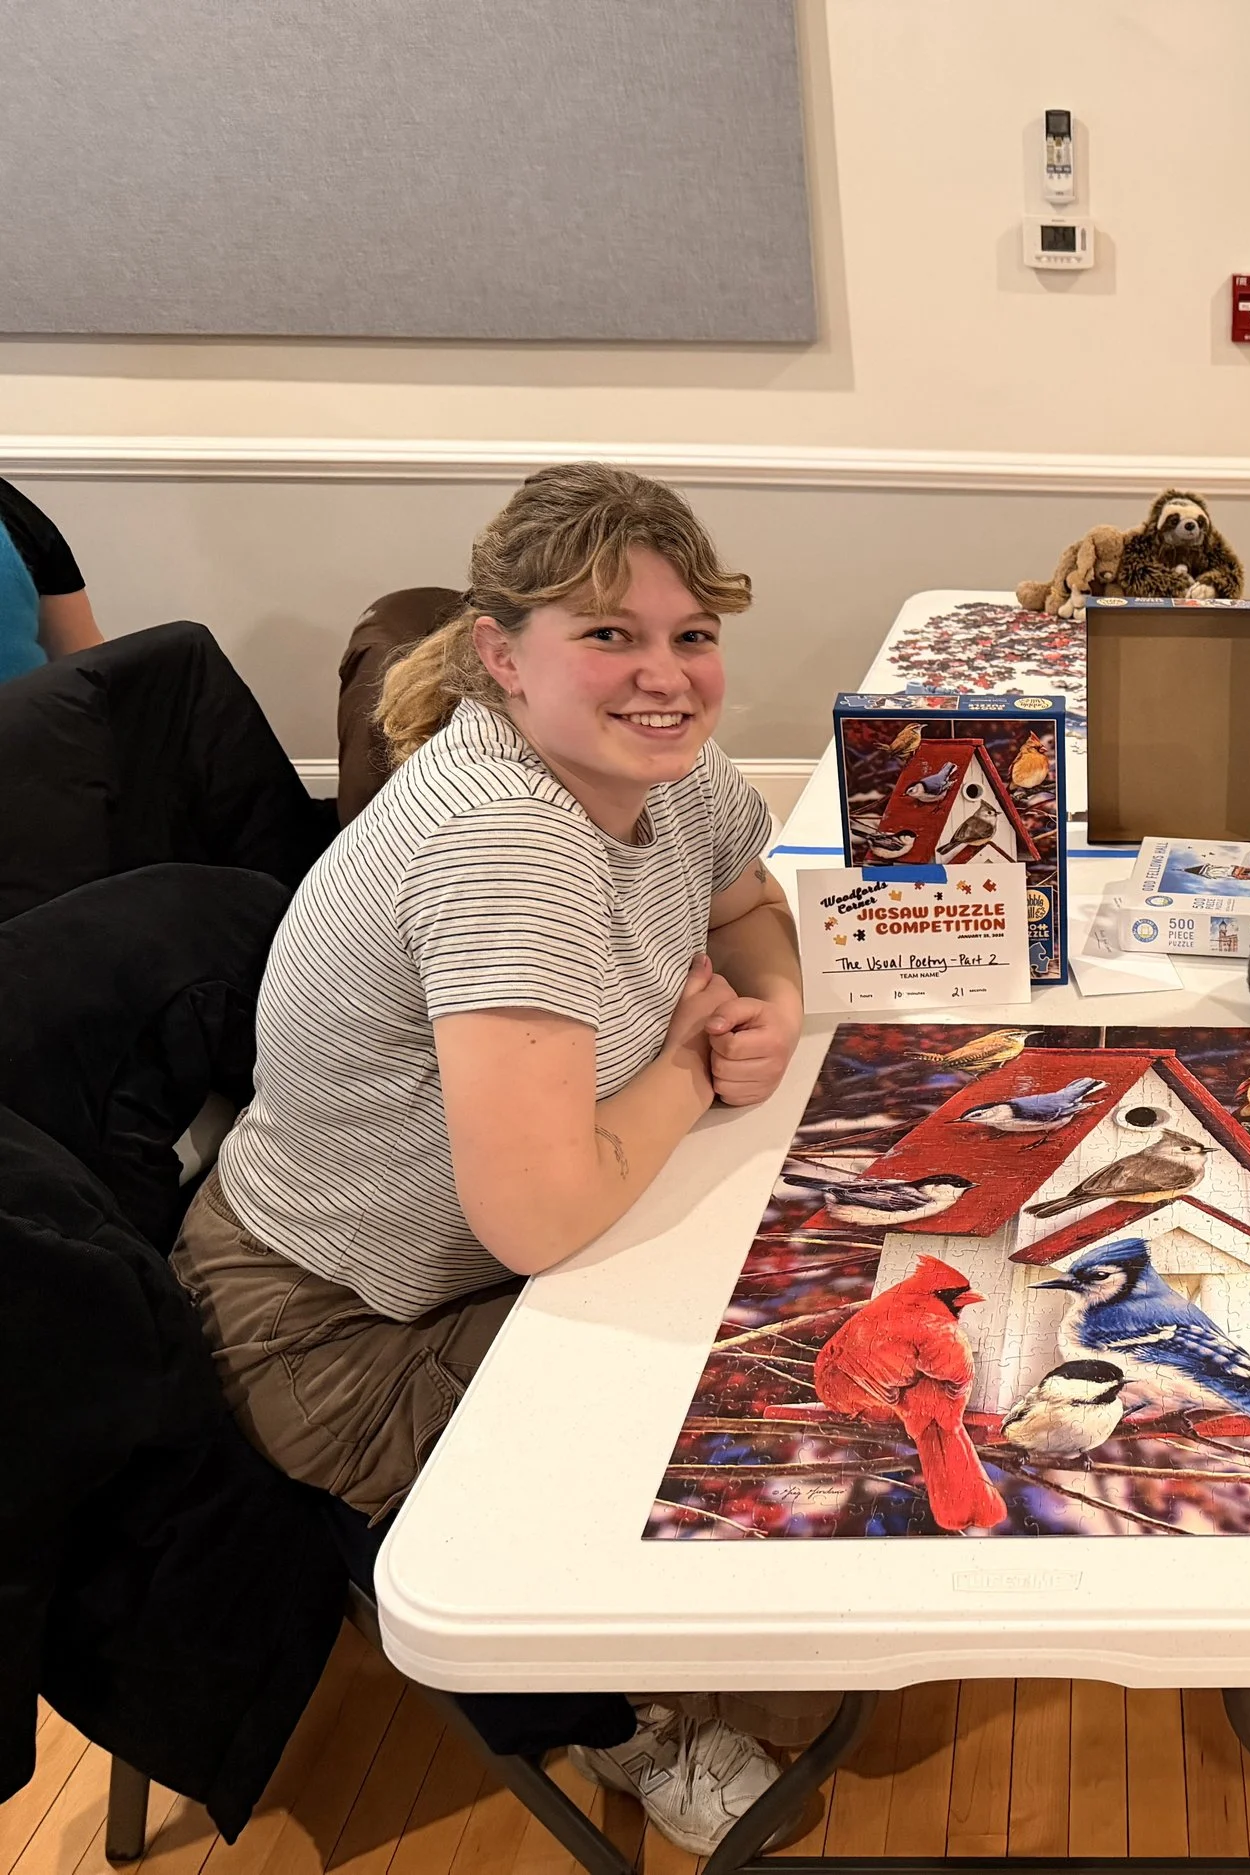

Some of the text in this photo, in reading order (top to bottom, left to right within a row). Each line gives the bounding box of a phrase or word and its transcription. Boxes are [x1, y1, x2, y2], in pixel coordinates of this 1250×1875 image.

[820, 880, 889, 909] Woodfords
[837, 896, 878, 915] Corner
[857, 903, 1005, 921] JIGSAW PUZZLE
[875, 917, 1006, 935] COMPETITION
[1169, 917, 1195, 931] 500
[1028, 930, 1051, 938] ZZLE
[1168, 930, 1195, 941] PIECE
[1168, 940, 1195, 948] PUZZLE
[836, 956, 862, 971] The
[866, 954, 902, 971] Usual
[909, 954, 948, 973] Poetry
[988, 953, 1000, 966] 2
[894, 991, 903, 1000] 10
[951, 987, 965, 998] 21
